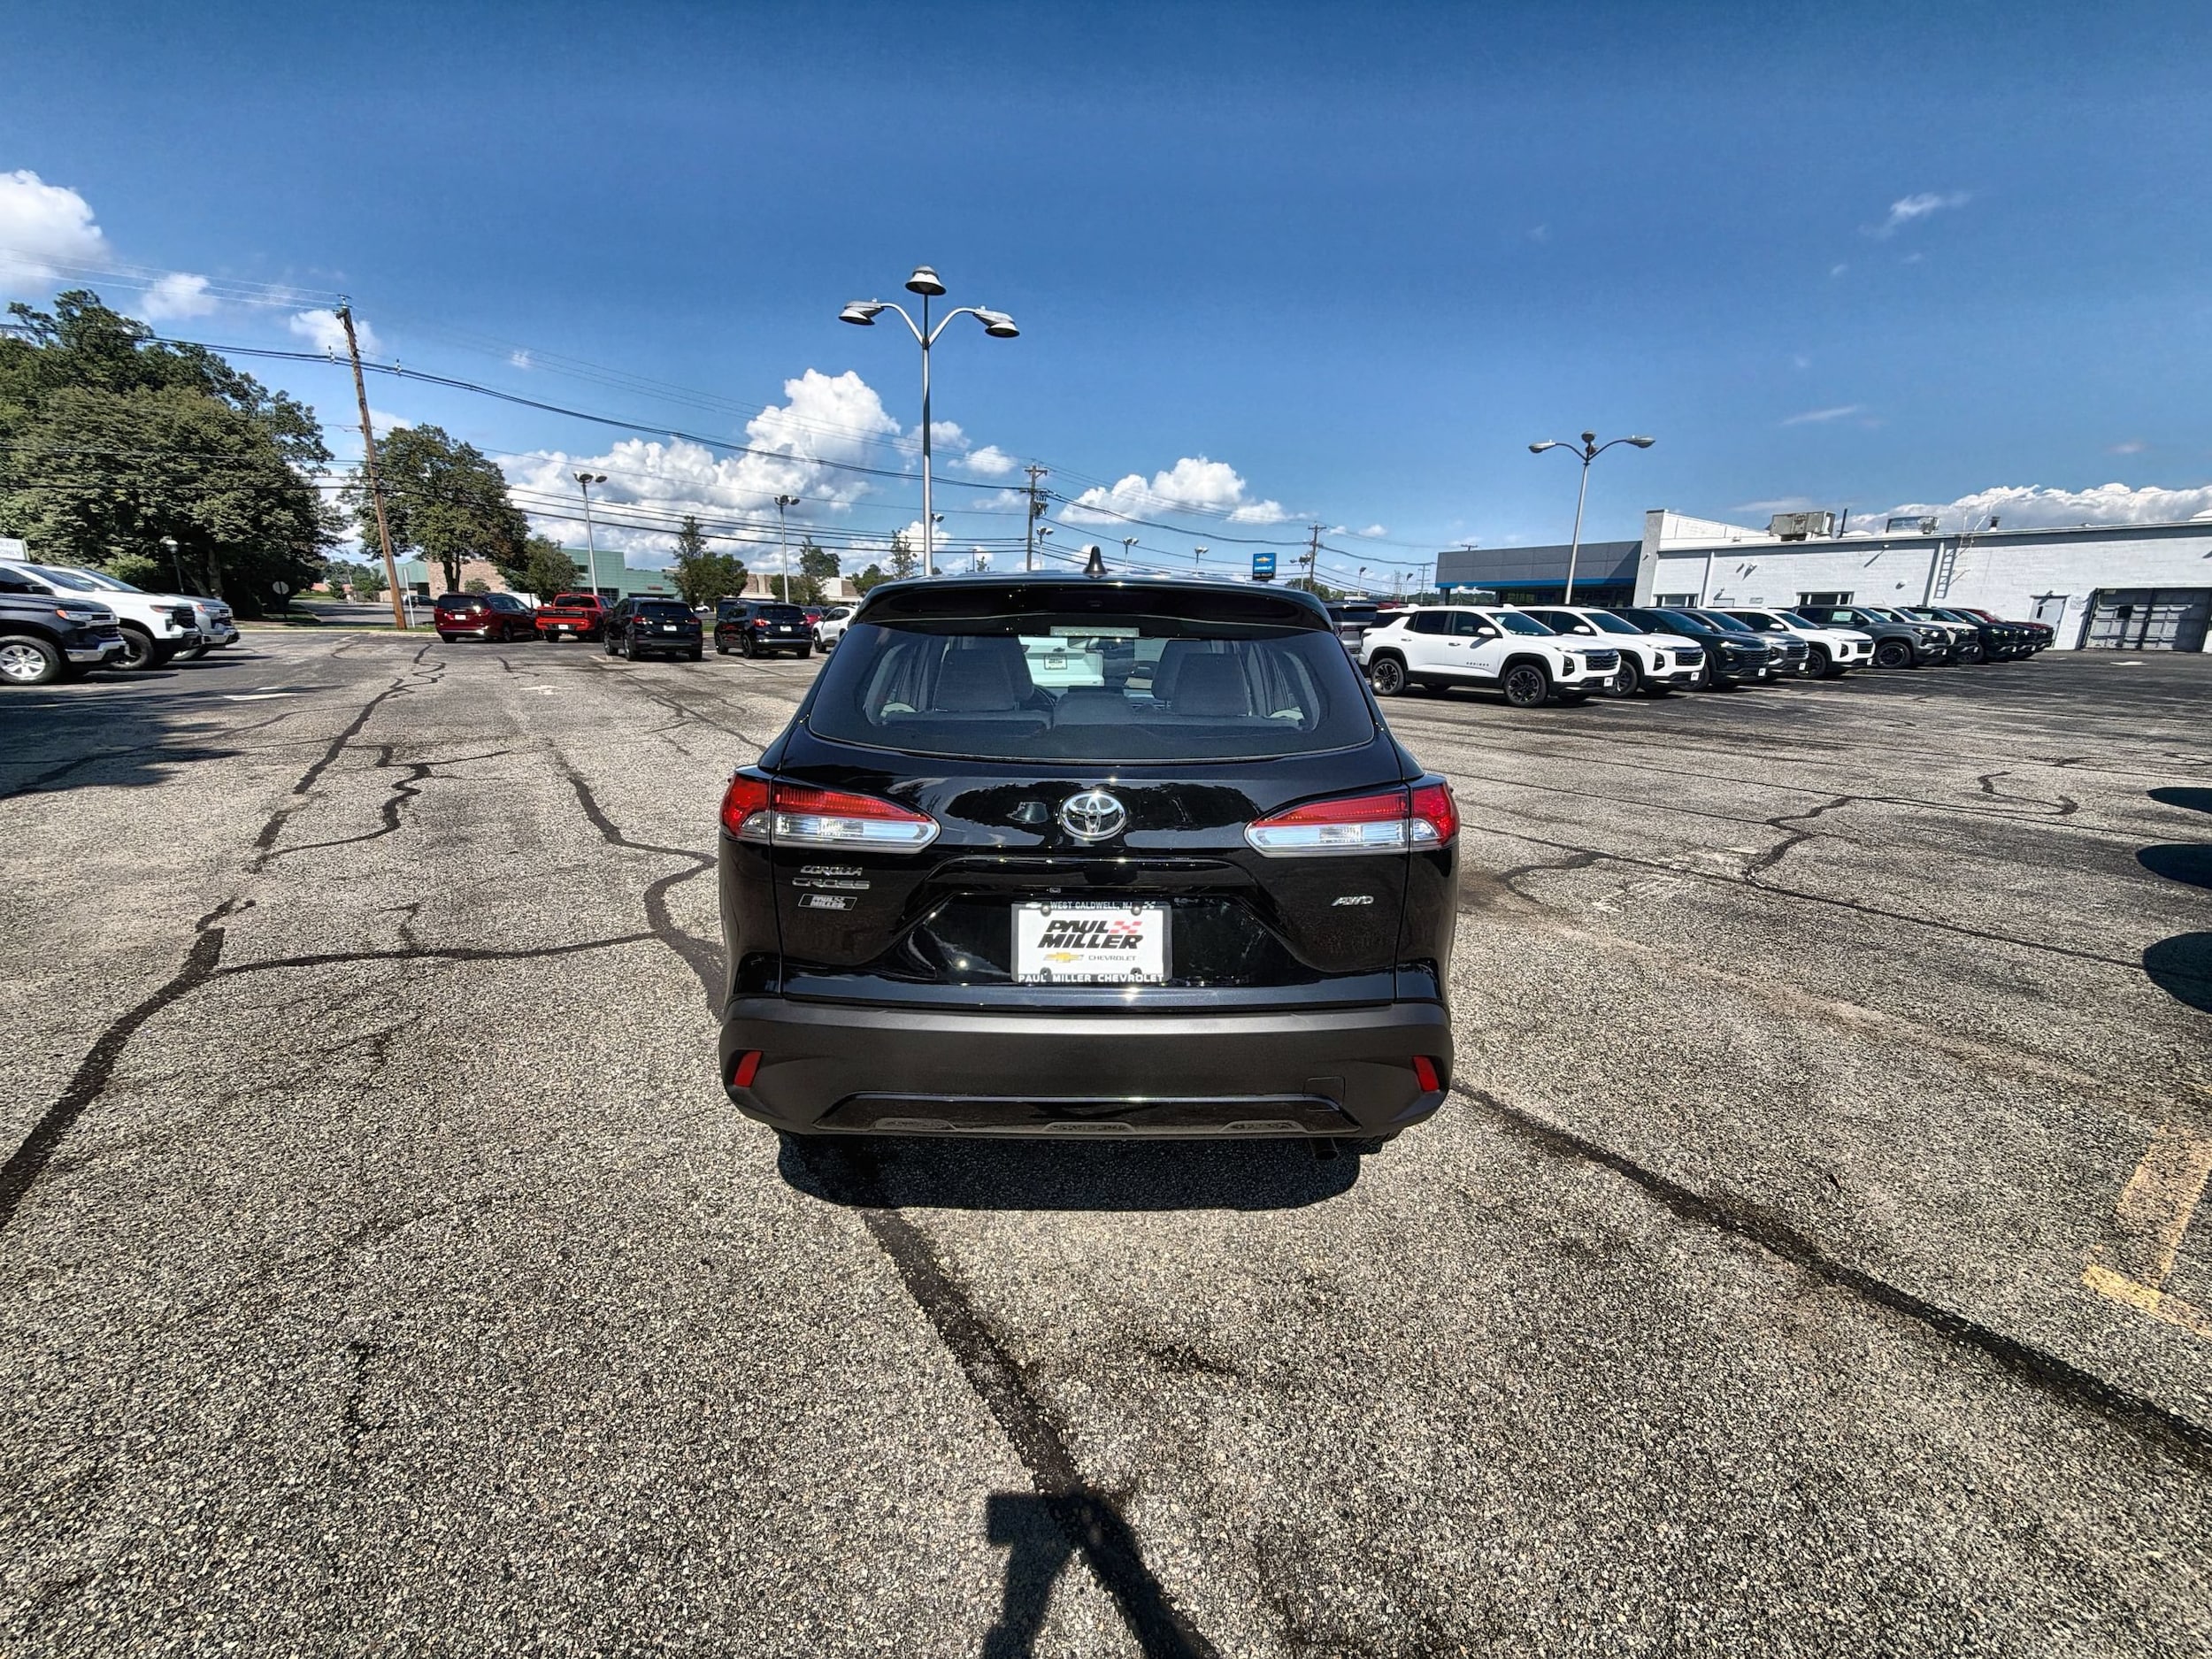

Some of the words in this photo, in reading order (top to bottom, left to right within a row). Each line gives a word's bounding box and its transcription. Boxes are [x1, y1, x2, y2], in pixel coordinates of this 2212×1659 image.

[800, 865, 863, 876] COROLLA
[792, 877, 871, 889] CROSS
[1075, 902, 1120, 910] CALDWELL,
[1331, 895, 1374, 907] AWD
[1045, 920, 1110, 933] PAUL
[1037, 933, 1144, 949] MILLER
